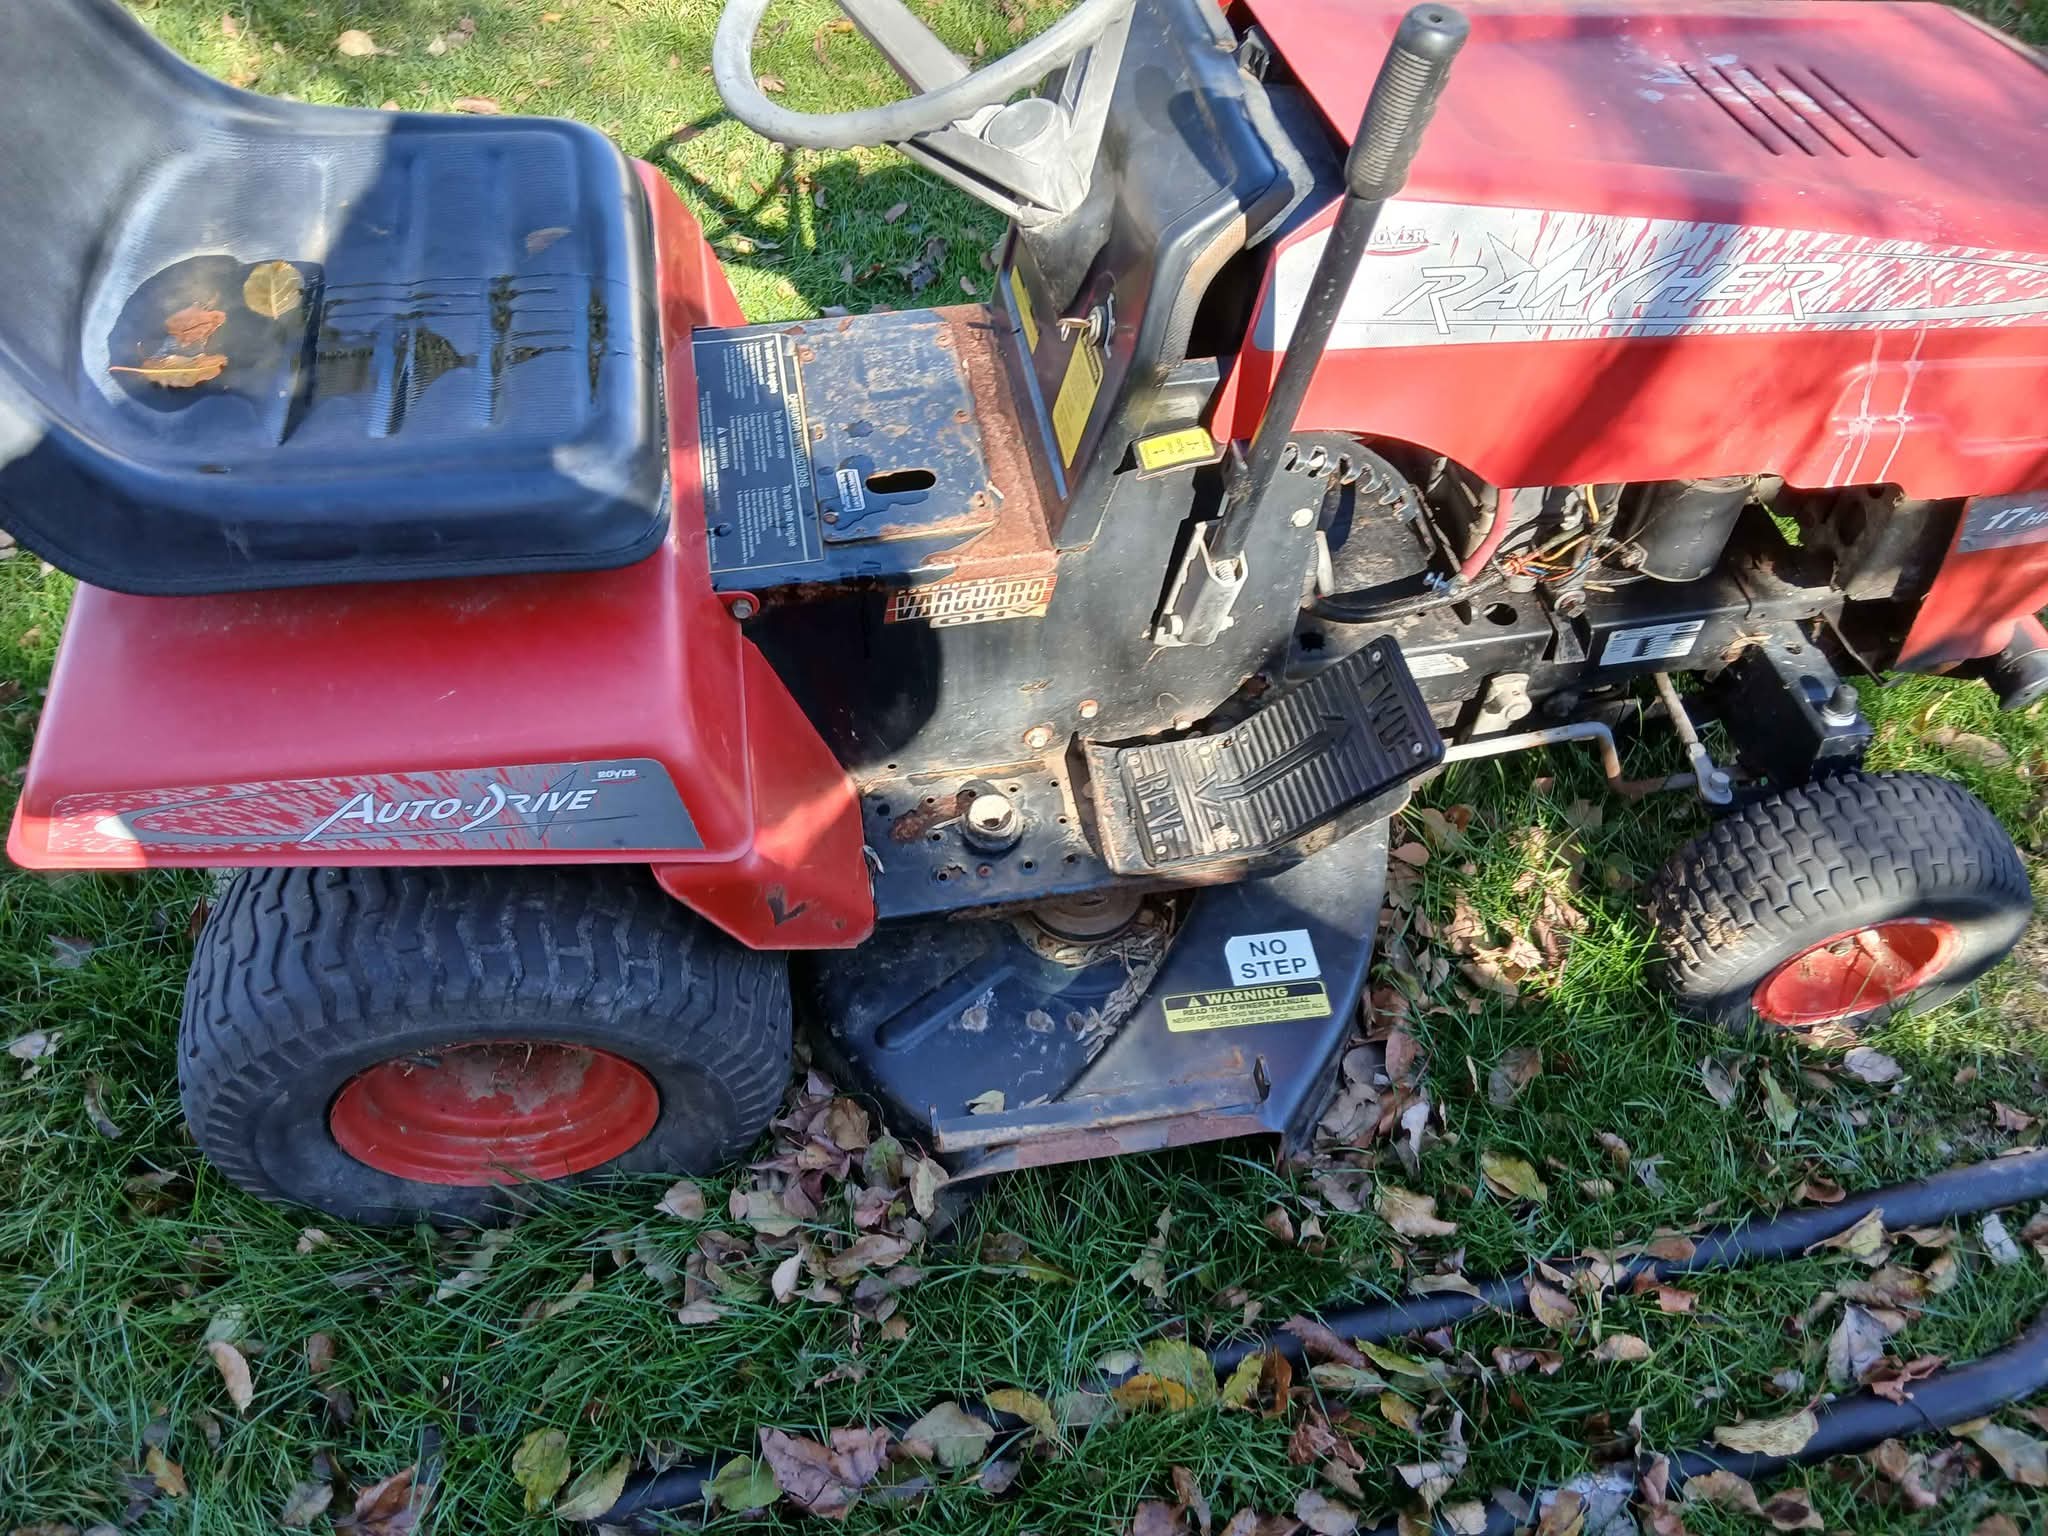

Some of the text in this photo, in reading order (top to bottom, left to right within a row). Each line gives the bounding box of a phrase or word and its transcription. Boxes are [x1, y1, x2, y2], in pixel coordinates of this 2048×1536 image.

[1368, 228, 1429, 244] OVER
[1382, 249, 1845, 335] RANCHER
[788, 393, 802, 432] OPERATOR
[718, 436, 730, 470] WARNING
[1982, 506, 2033, 531] 17
[895, 579, 1046, 620] VANGUARD
[598, 769, 637, 779] ROVER
[1249, 939, 1287, 957] NO
[1240, 957, 1307, 979] STEP
[1183, 1007, 1207, 1016] READ
[1232, 1001, 1271, 1011] OWNERS
[1273, 997, 1310, 1007] MANUAL
[1204, 987, 1289, 1005] WARNING
[1172, 1016, 1196, 1024] NEVER
[1197, 1012, 1231, 1022] OPERATE
[1249, 1007, 1282, 1016] MACHINE
[1282, 1004, 1310, 1012] UNLESS
